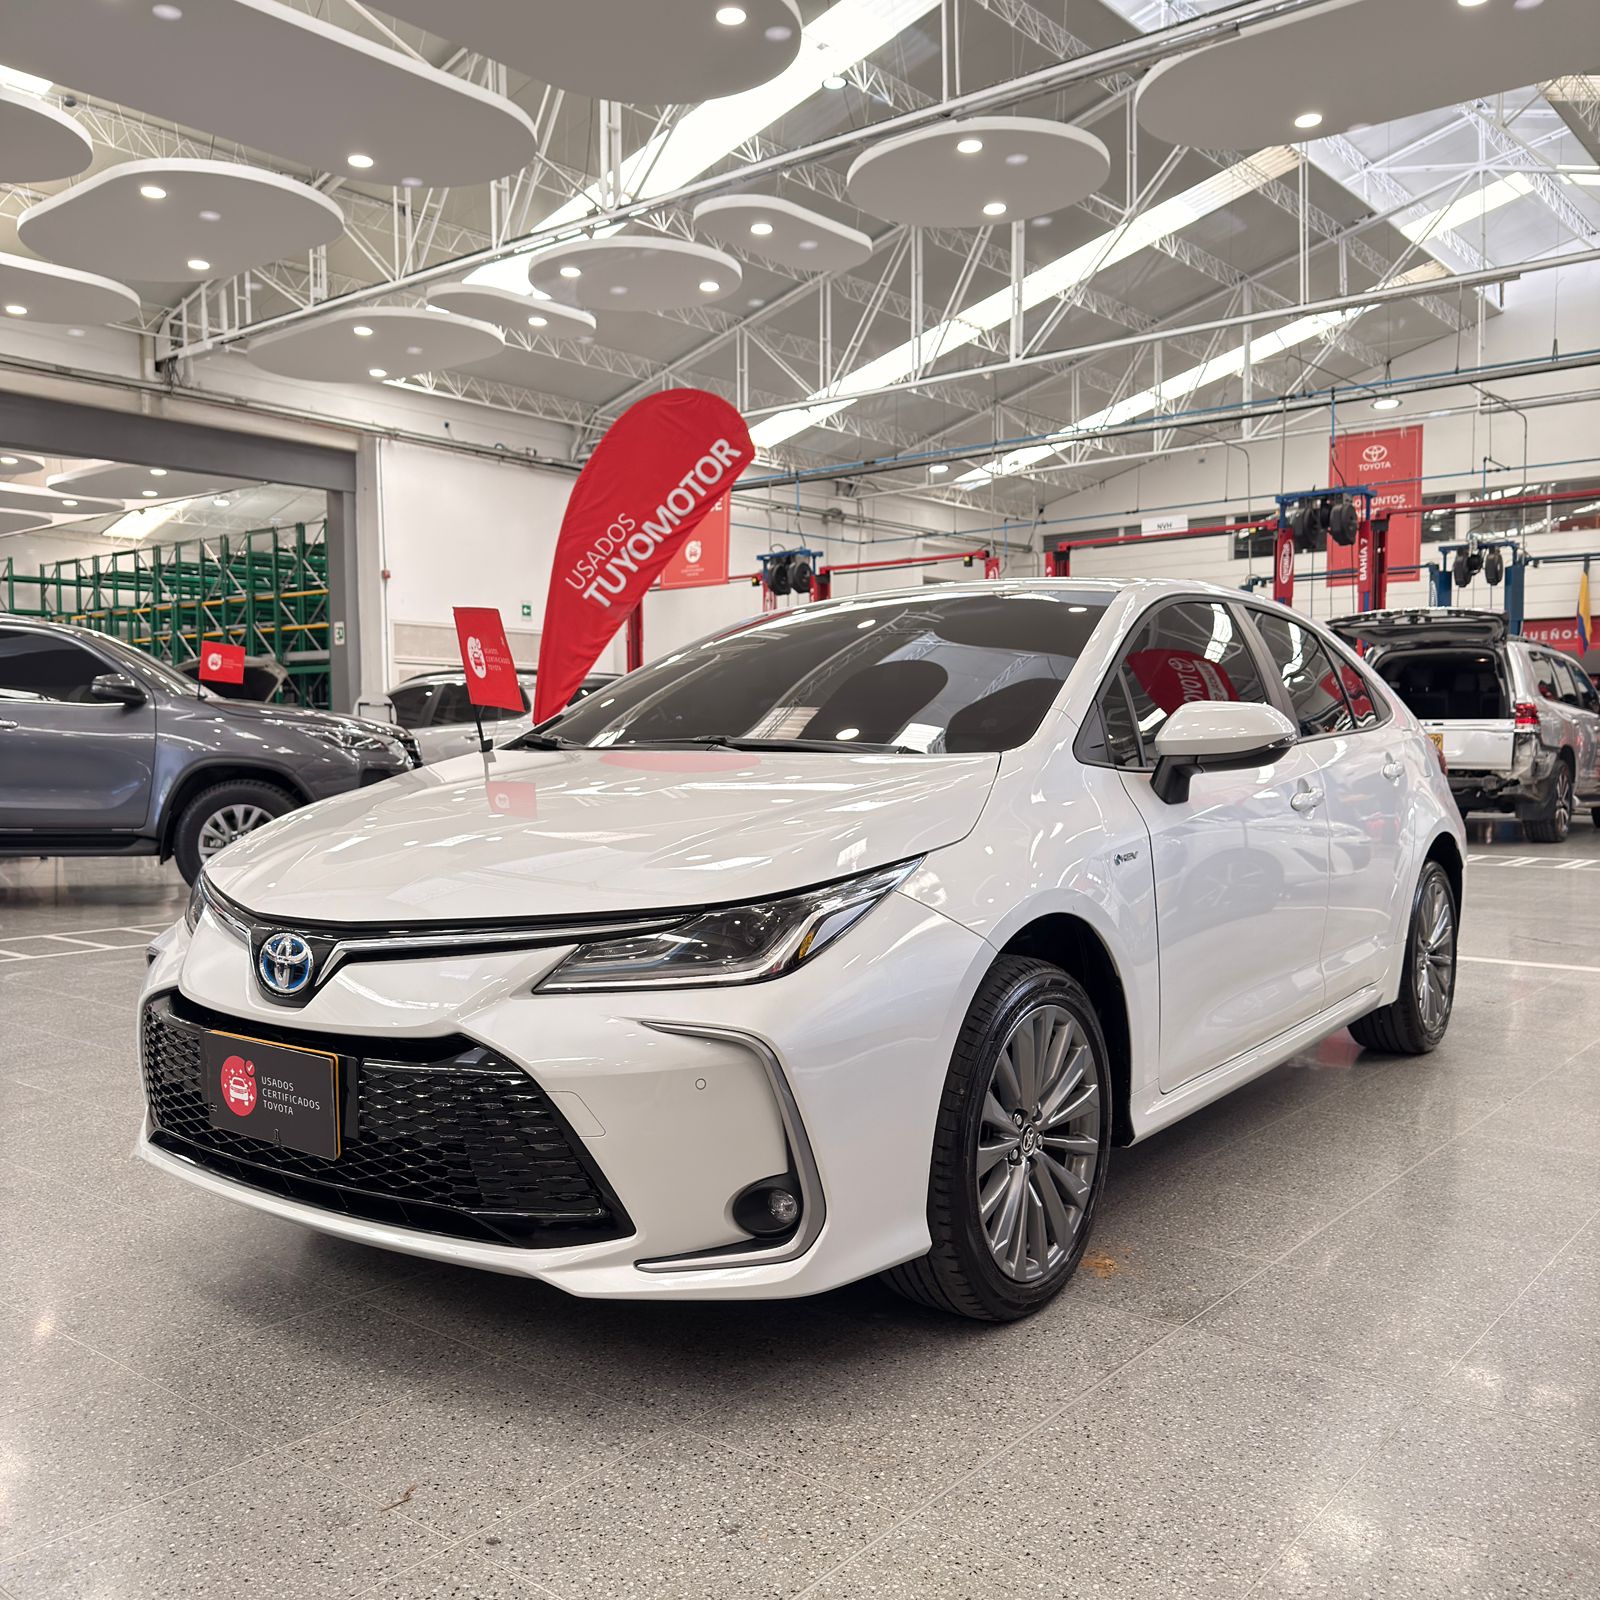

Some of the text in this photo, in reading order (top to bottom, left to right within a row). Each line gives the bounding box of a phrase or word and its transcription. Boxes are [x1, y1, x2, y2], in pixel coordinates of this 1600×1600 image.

[1358, 461, 1391, 472] TOYOTA
[1370, 494, 1406, 506] UNTOS
[582, 437, 742, 608] TUYOMOTOR
[1157, 522, 1172, 530] NVH
[564, 512, 636, 590] USADOS
[1359, 546, 1368, 581] BAHÍA
[261, 1076, 294, 1092] USADOS
[262, 1088, 321, 1111] CERTIFICADOS
[263, 1100, 294, 1116] TOYOTA
